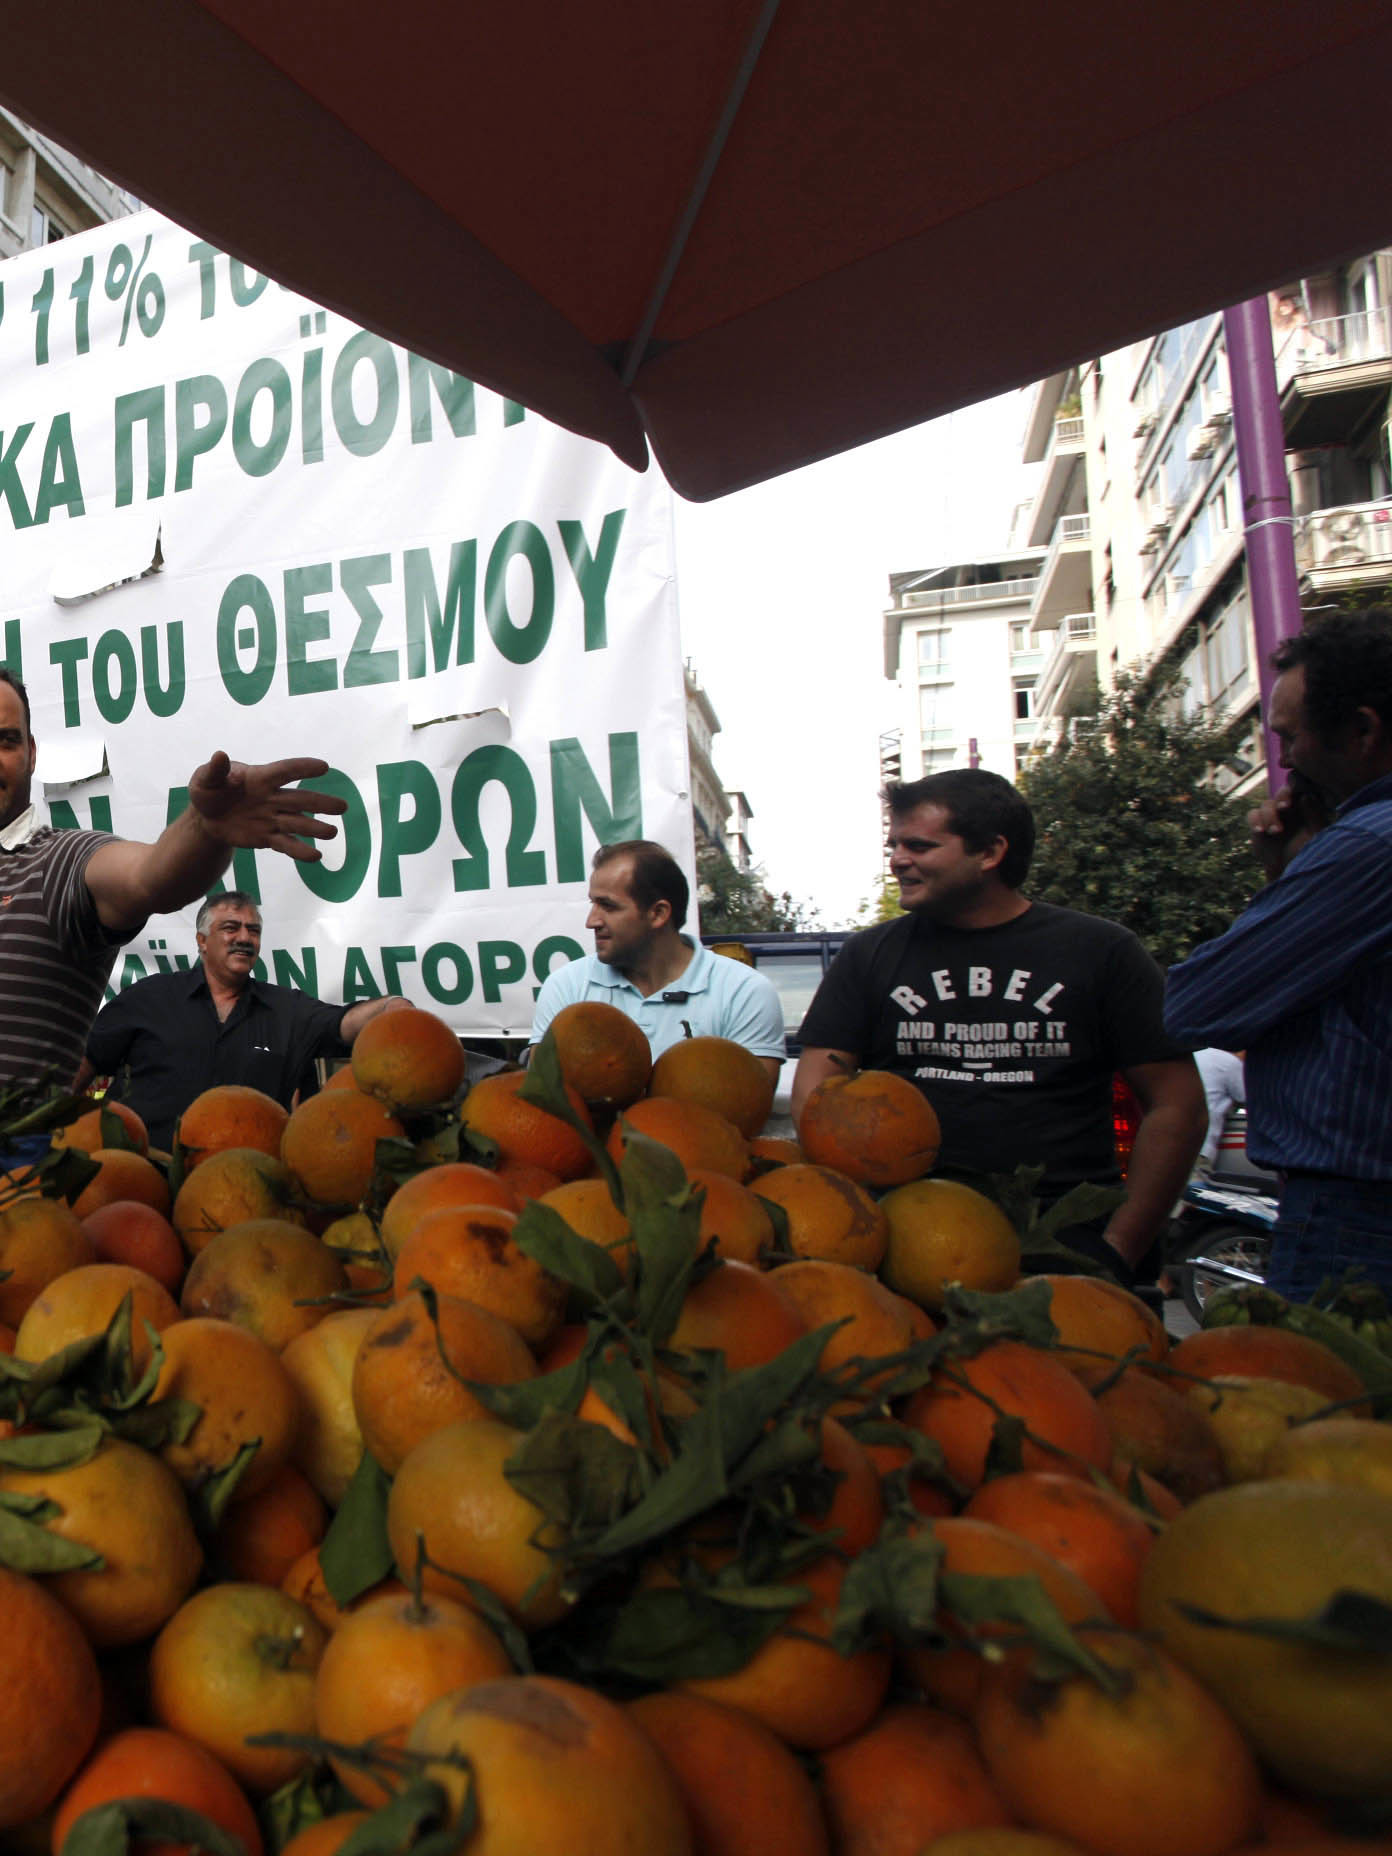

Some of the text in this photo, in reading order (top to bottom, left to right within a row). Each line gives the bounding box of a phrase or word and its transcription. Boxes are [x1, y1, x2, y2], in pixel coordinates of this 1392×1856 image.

[31, 234, 165, 367] 11%
[188, 239, 291, 321] το
[114, 310, 525, 508] ΠΡΟΪΟΝ
[49, 620, 186, 728] του
[216, 508, 627, 707] ΘΕΣΜΟΥ
[164, 732, 643, 906] ΟΡΩΝ
[889, 966, 1065, 1016] REBEL
[896, 1021, 1067, 1042] AND PROUD OF IT
[915, 1067, 974, 1082] PORTLAND
[983, 1070, 1034, 1083] OREGON
[963, 1043, 1022, 1059] RACING
[1024, 1042, 1071, 1057] TEAM
